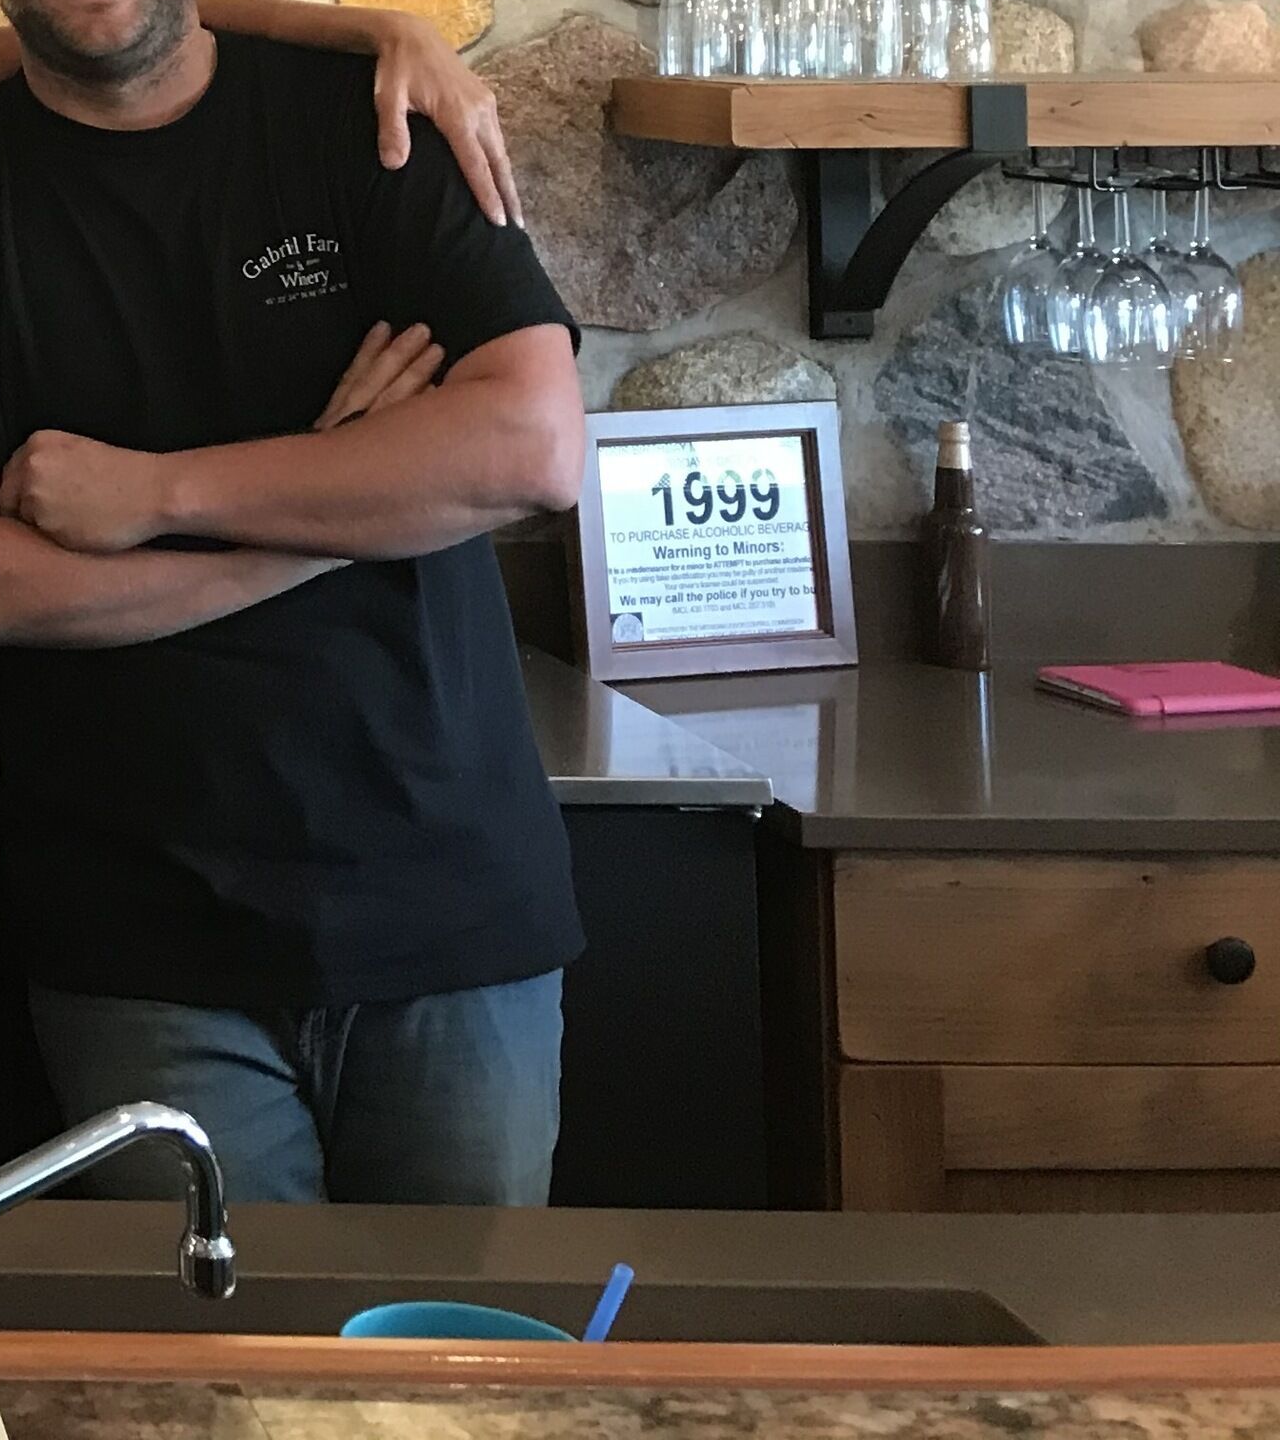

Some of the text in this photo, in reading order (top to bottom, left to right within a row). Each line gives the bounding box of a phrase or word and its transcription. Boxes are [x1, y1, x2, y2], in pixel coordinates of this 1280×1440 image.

[651, 468, 781, 527] 1999
[610, 532, 626, 544] TO
[628, 528, 690, 543] PURCHASE
[692, 524, 755, 540] ALCOHOLIC
[652, 541, 785, 561] Warning to Minors:
[713, 559, 744, 568] ATTEMPT
[619, 595, 637, 607] We
[639, 595, 662, 608] may
[665, 592, 684, 603] call
[686, 591, 704, 602] the
[706, 588, 738, 603] police
[740, 587, 748, 598] if
[749, 588, 770, 601] you
[771, 587, 787, 599] try
[789, 585, 801, 596] to
